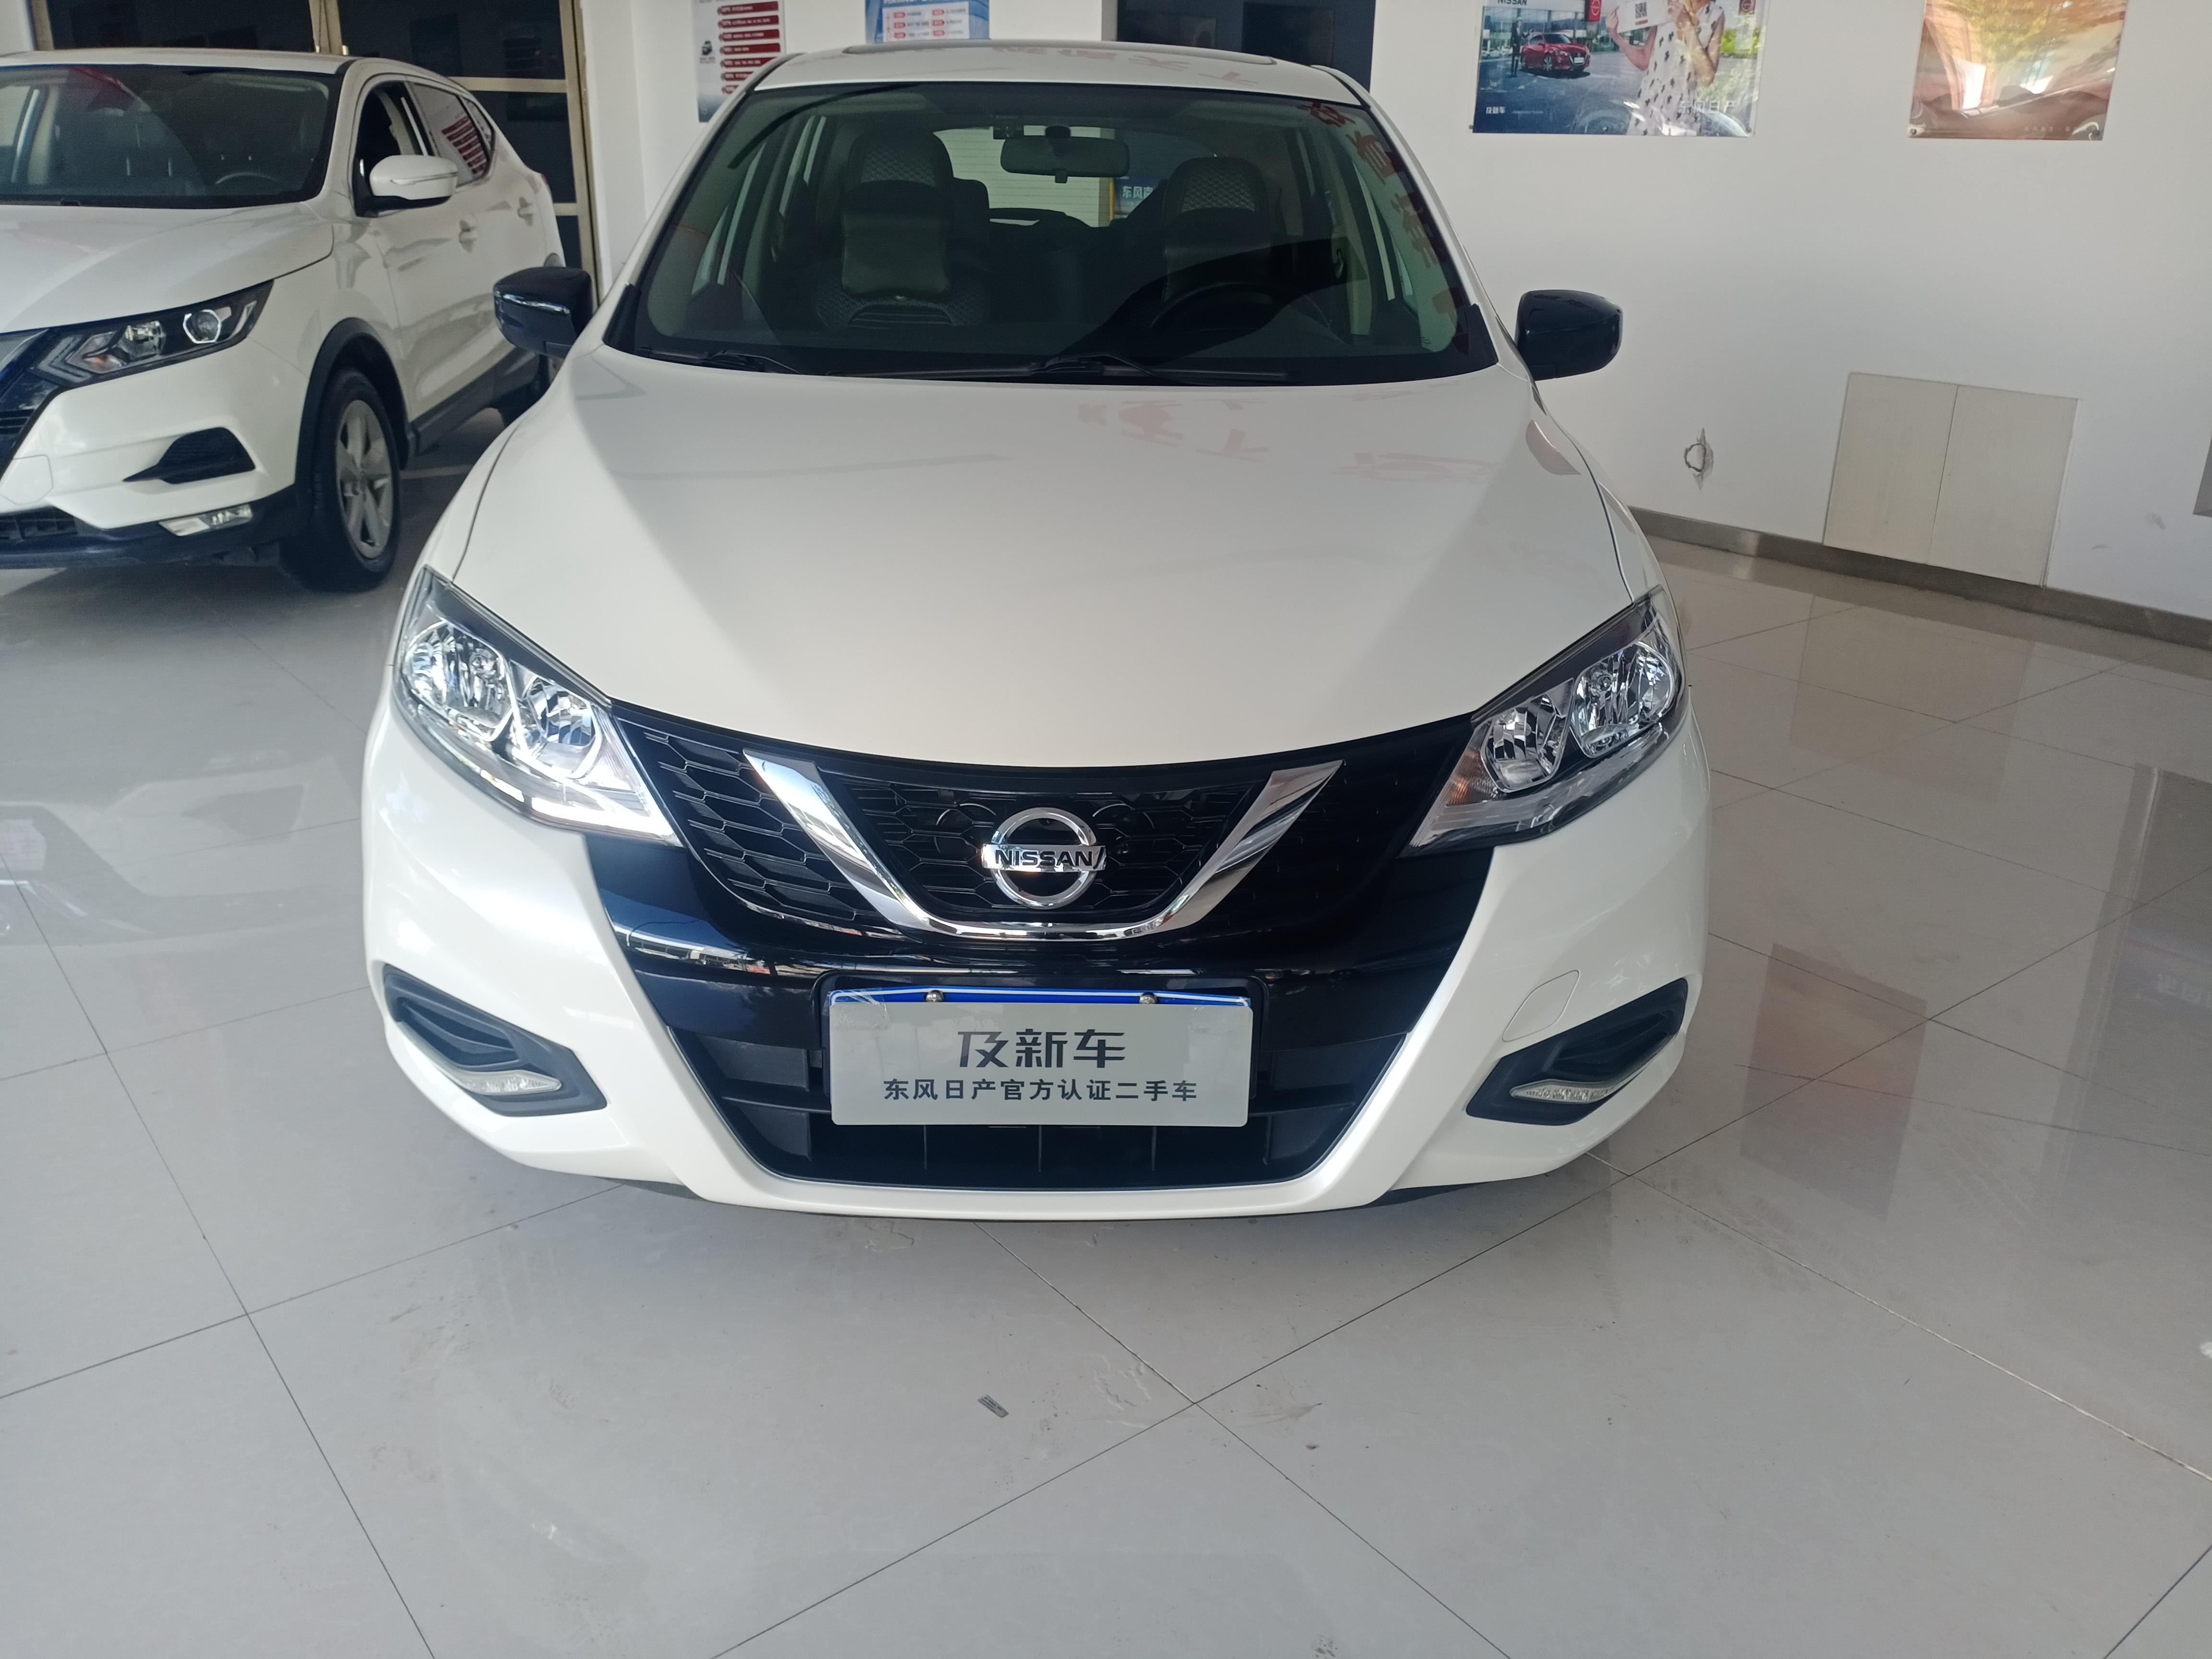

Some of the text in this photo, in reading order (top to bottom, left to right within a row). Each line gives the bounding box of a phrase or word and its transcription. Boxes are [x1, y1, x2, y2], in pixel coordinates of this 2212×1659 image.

[995, 850, 1093, 866] NISSAN
[958, 1028, 1126, 1069] 及新车
[883, 1079, 1197, 1102] 东风日产官方认证二手车
